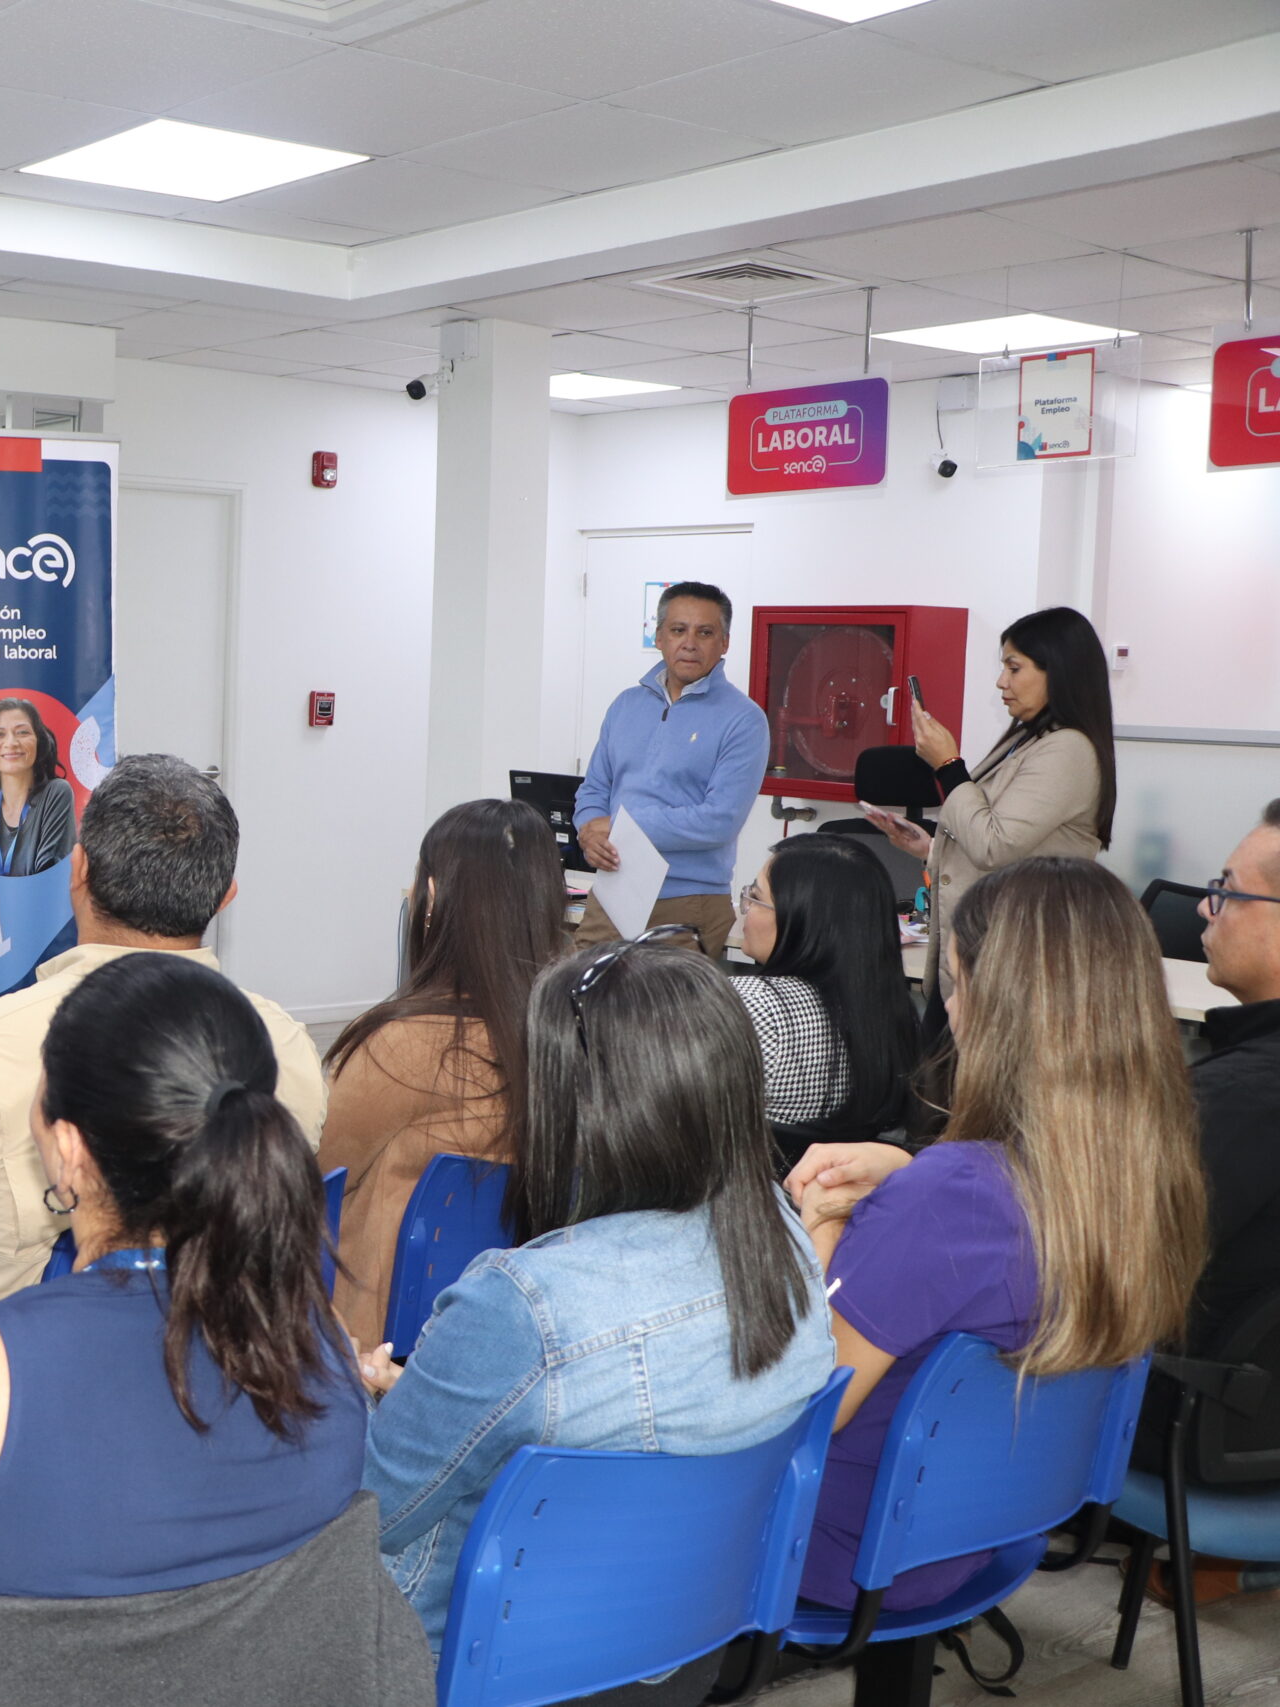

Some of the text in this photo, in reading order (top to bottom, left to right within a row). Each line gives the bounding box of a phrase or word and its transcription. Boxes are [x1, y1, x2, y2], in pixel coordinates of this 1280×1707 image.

[1034, 397, 1077, 407] Plataforma
[772, 404, 839, 421] PLATAFORMA
[1041, 406, 1071, 415] Empleo
[757, 423, 856, 453] LABORAL
[783, 455, 827, 475] sence
[4, 645, 57, 660] laboral
